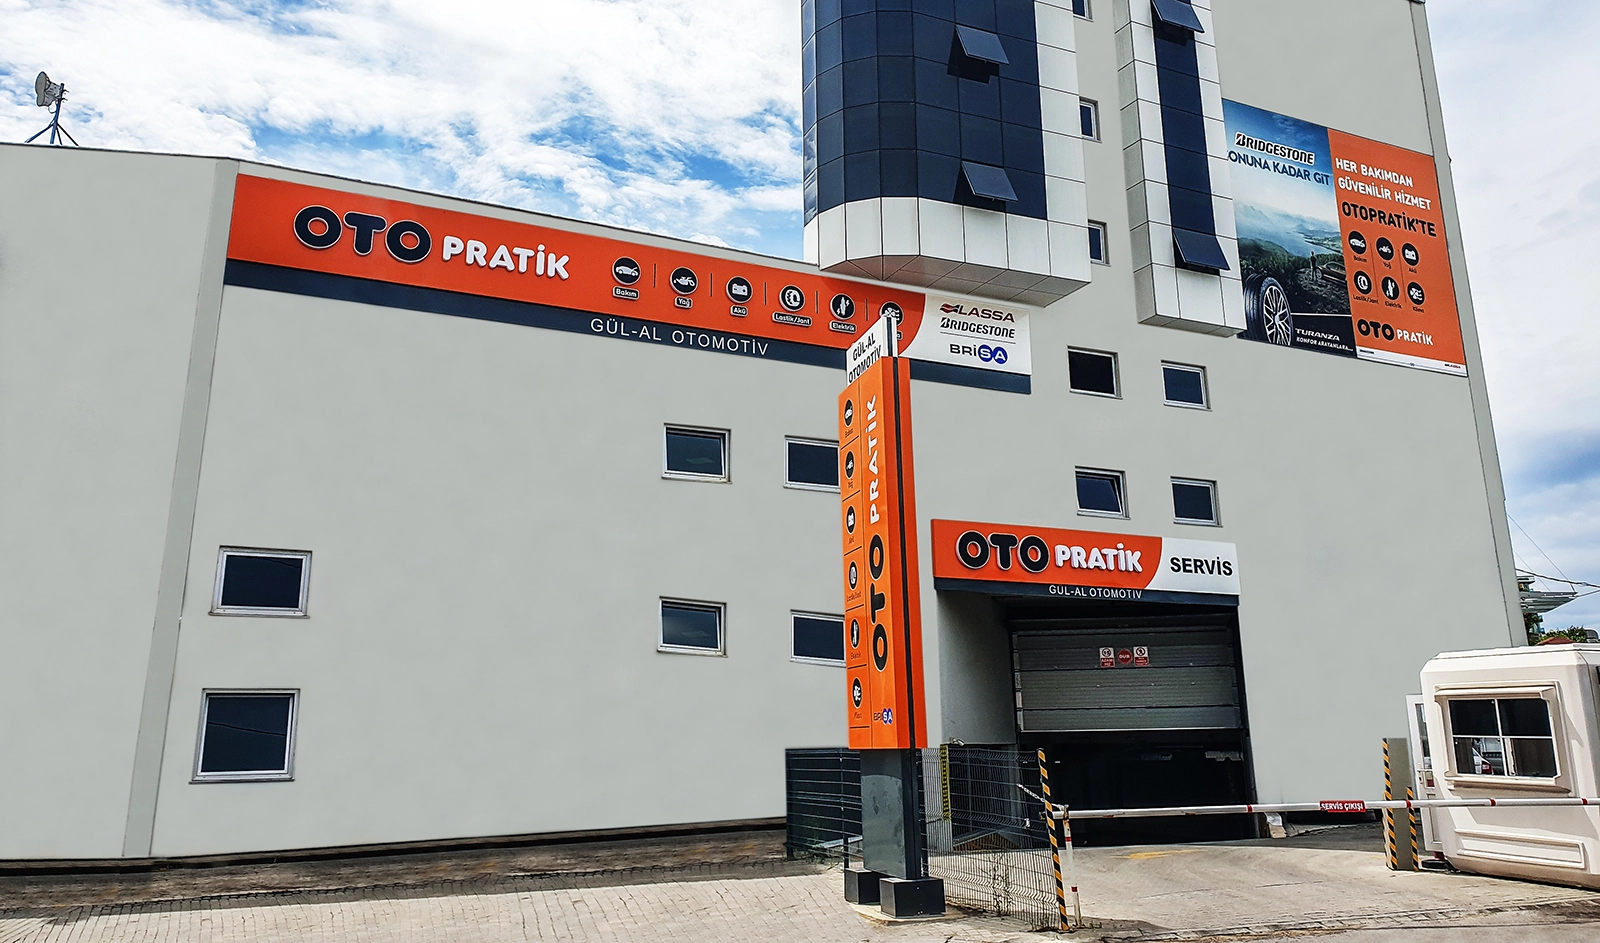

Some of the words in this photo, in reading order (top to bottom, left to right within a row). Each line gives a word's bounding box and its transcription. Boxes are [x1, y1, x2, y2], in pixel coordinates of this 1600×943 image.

[1236, 133, 1314, 165] BRIDGESTONE
[1228, 150, 1271, 171] ONUNA
[1273, 161, 1311, 181] KADAR
[1335, 158, 1358, 173] HER
[1361, 164, 1413, 187] BAKIMDAN
[1338, 175, 1391, 200] GÜVENİLİR
[1394, 190, 1431, 210] HİZMET
[293, 205, 432, 263] OTO
[442, 235, 570, 279] PRATİK
[940, 317, 1016, 339] BRIDGESTONE
[958, 305, 1015, 323] LASSA
[590, 318, 662, 341] GÜL-AL
[671, 330, 768, 355] OTOMOTİV
[1295, 328, 1340, 341] TURANZA
[1357, 319, 1395, 341] OTO
[1396, 330, 1434, 346] PRATİK
[865, 394, 880, 525] PRATİK
[956, 530, 1050, 573] OTO
[1055, 543, 1143, 573] PRATİK
[1170, 556, 1233, 577] SERVİS
[869, 534, 888, 672] OTO
[1321, 802, 1343, 810] SERVİS
[1344, 802, 1363, 811] ÇIKIŞI
